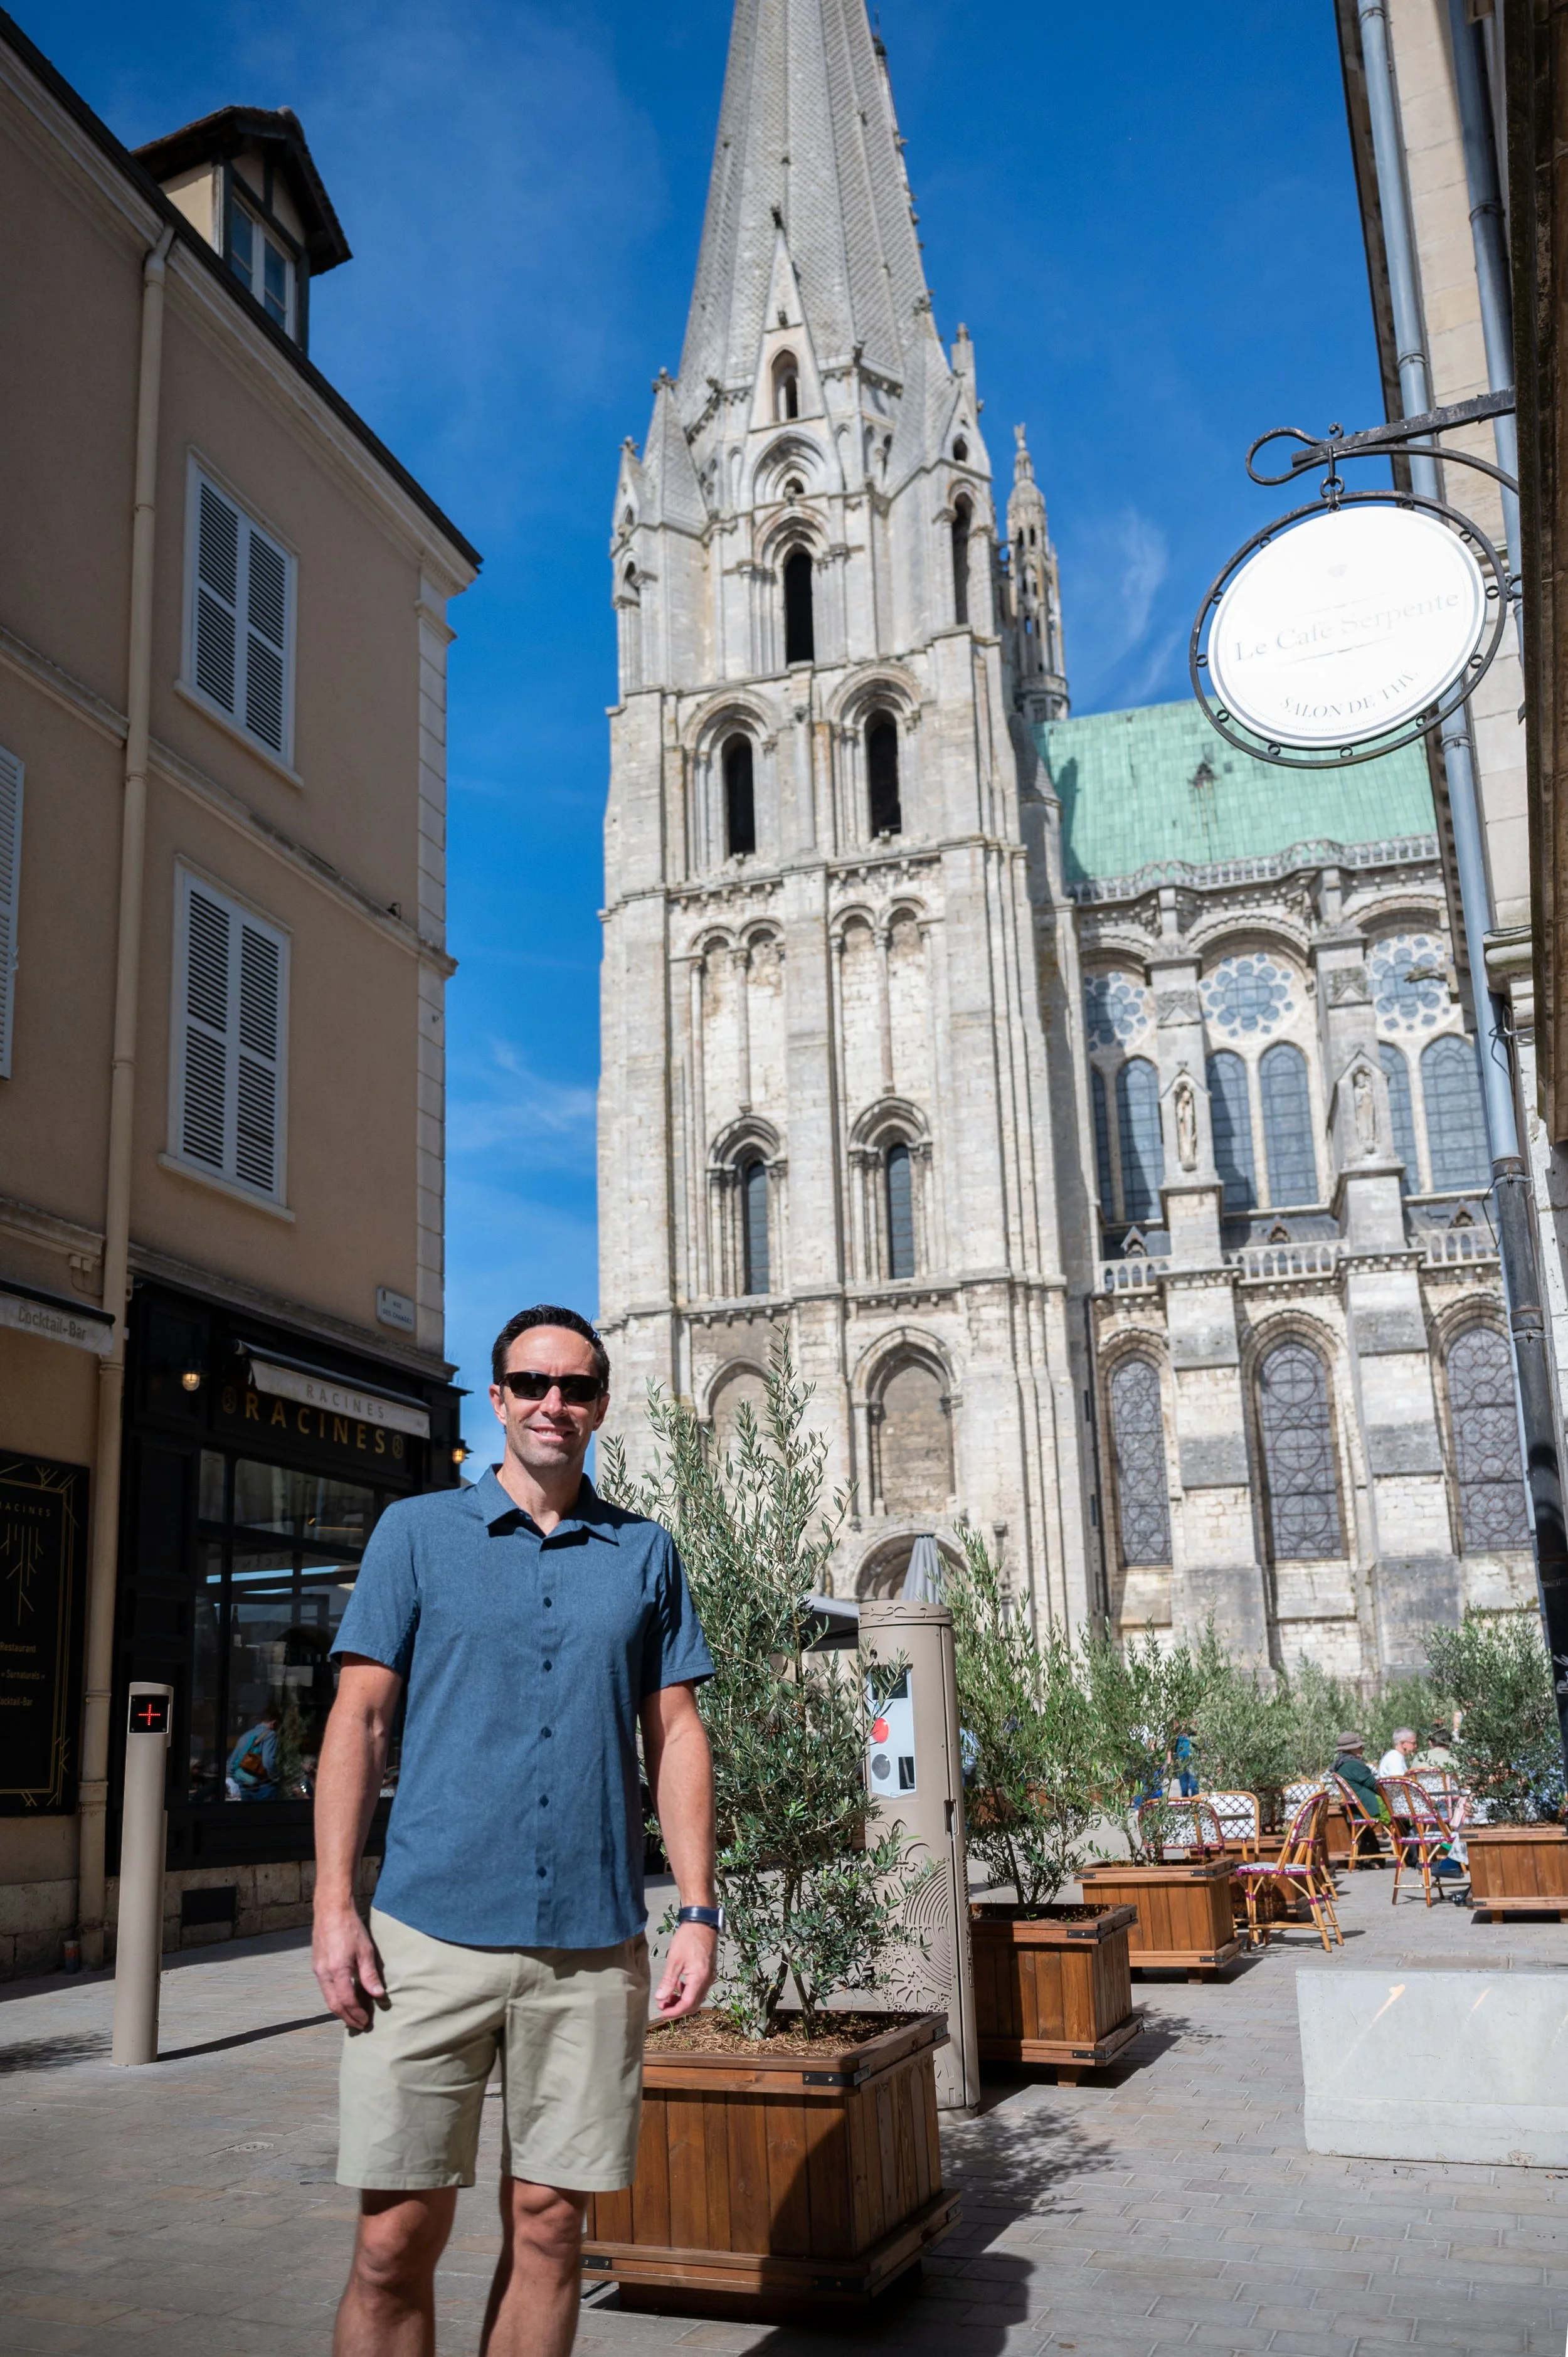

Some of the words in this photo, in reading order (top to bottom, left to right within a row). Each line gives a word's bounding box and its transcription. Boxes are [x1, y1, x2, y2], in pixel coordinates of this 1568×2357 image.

[1235, 641, 1268, 662] Le
[1340, 593, 1458, 634] Serpente
[1279, 696, 1342, 718] SALON
[1347, 695, 1374, 714] DE
[18, 1306, 87, 1341] Cocktail-Bar
[305, 1384, 384, 1419] RACINES
[244, 1390, 387, 1454] RACINES
[0, 1695, 33, 1707] ocktail-Bar
